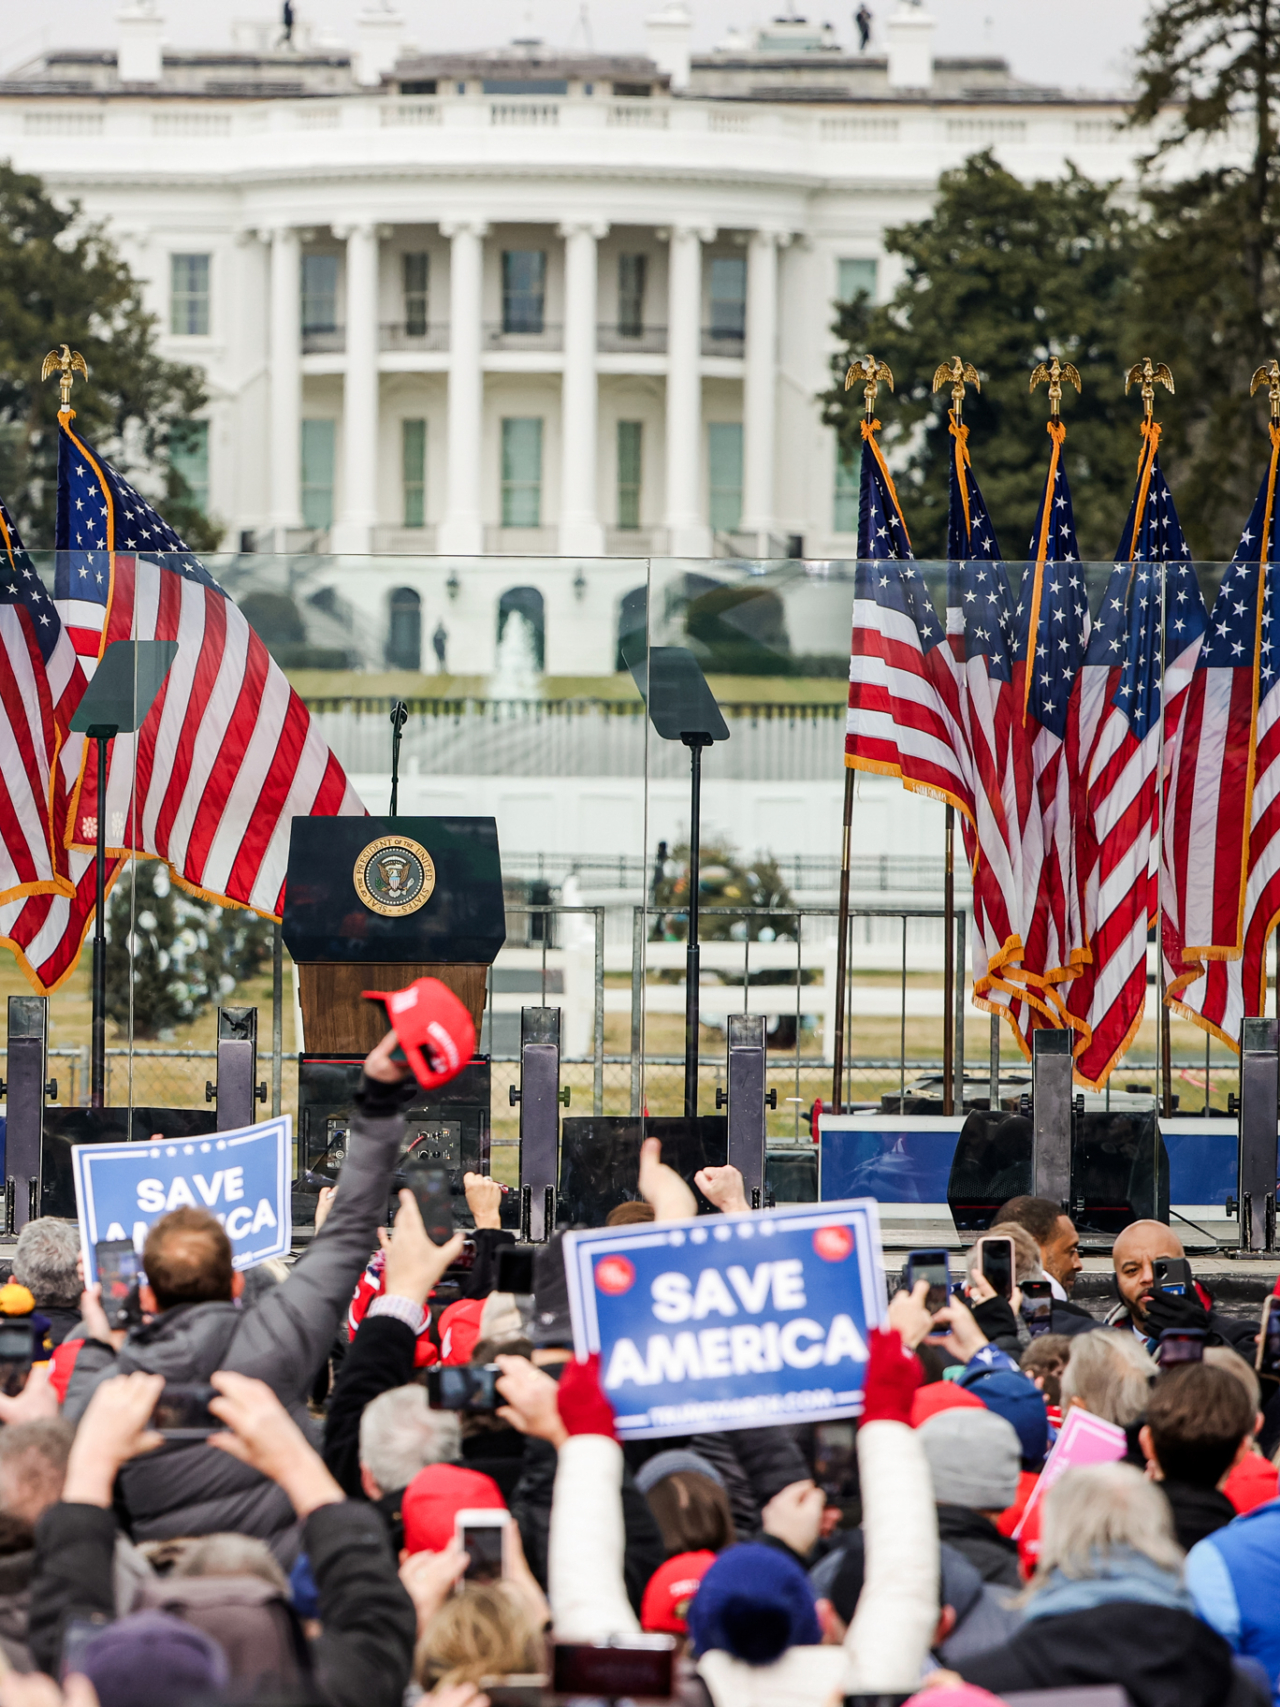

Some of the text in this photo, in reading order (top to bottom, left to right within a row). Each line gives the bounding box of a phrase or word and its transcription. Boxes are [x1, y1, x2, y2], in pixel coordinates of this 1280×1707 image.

[356, 838, 393, 874] PRESIDENT
[404, 840, 414, 849] THE
[415, 848, 433, 881] UNITED
[367, 899, 387, 913] SEAL
[402, 888, 429, 913] STATES
[136, 1166, 245, 1213] SAVE
[651, 1258, 807, 1323] SAVE
[604, 1313, 870, 1389] AMERICA
